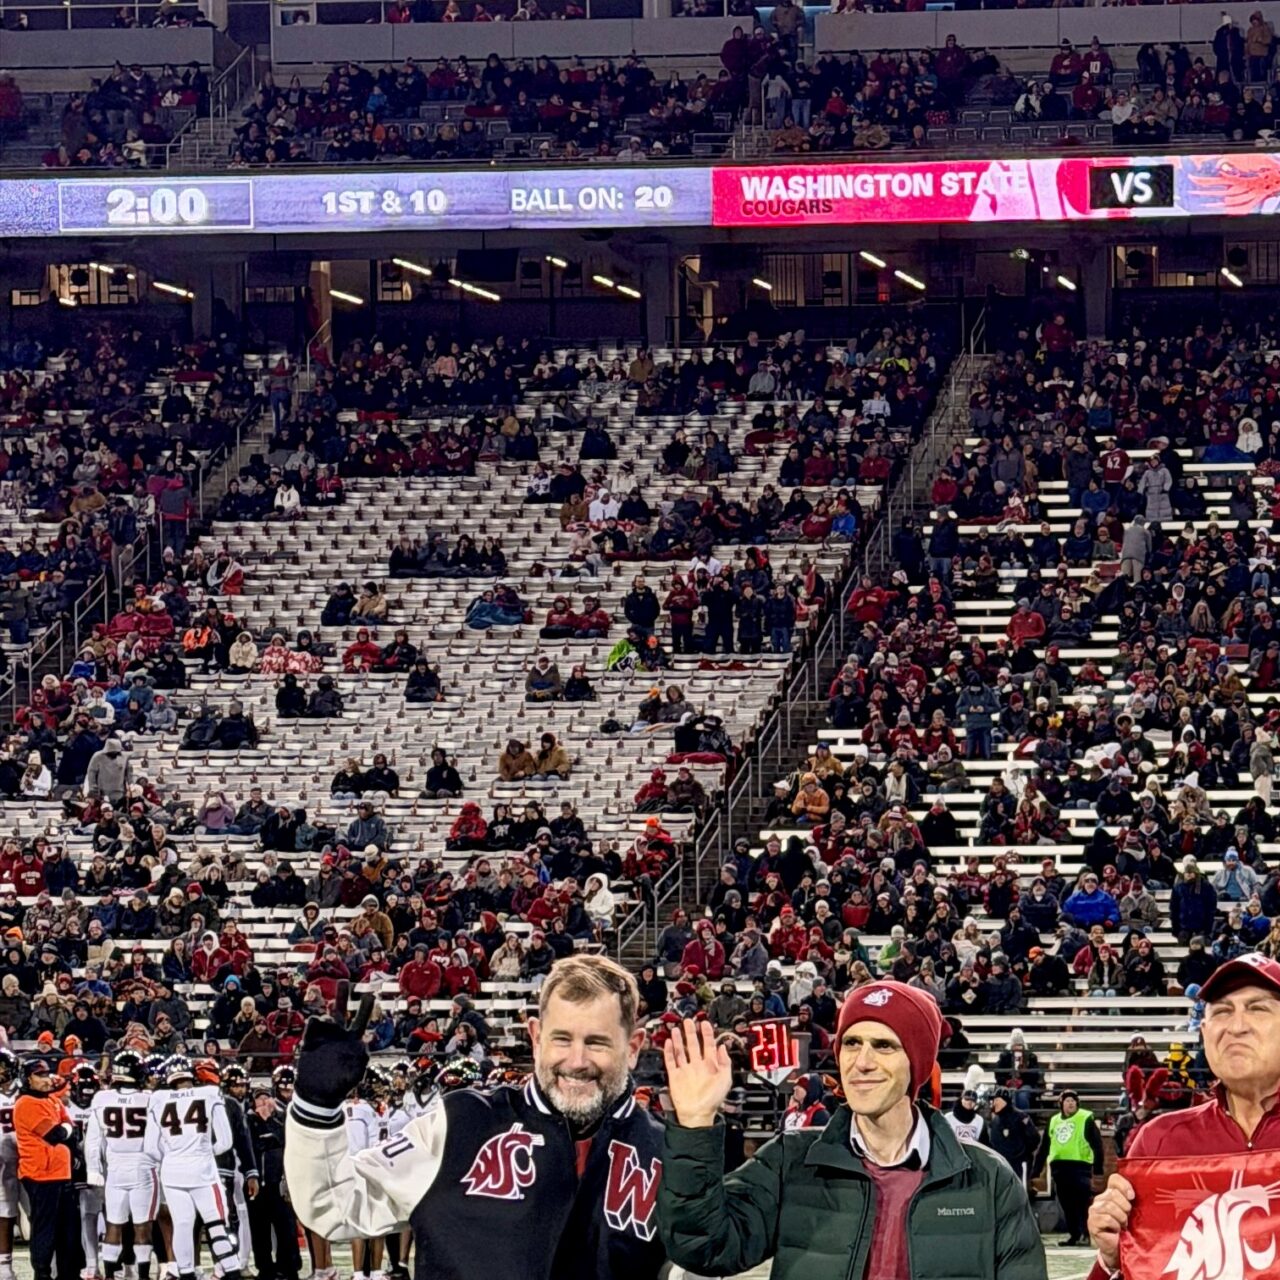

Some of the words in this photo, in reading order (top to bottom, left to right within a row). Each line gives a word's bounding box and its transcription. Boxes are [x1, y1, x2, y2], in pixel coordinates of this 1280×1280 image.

[511, 188, 572, 211] BALL
[578, 187, 624, 210] ON:
[634, 185, 673, 209] 20
[740, 172, 934, 200] WASHINGTON
[940, 170, 1027, 196] STATE
[1110, 172, 1153, 204] VS
[106, 188, 208, 225] 2:00
[322, 191, 375, 214] 1ST
[381, 191, 402, 213] &
[410, 189, 447, 213] 10
[742, 199, 833, 215] COUGARS
[103, 1106, 147, 1139] 95
[160, 1099, 209, 1136] 44
